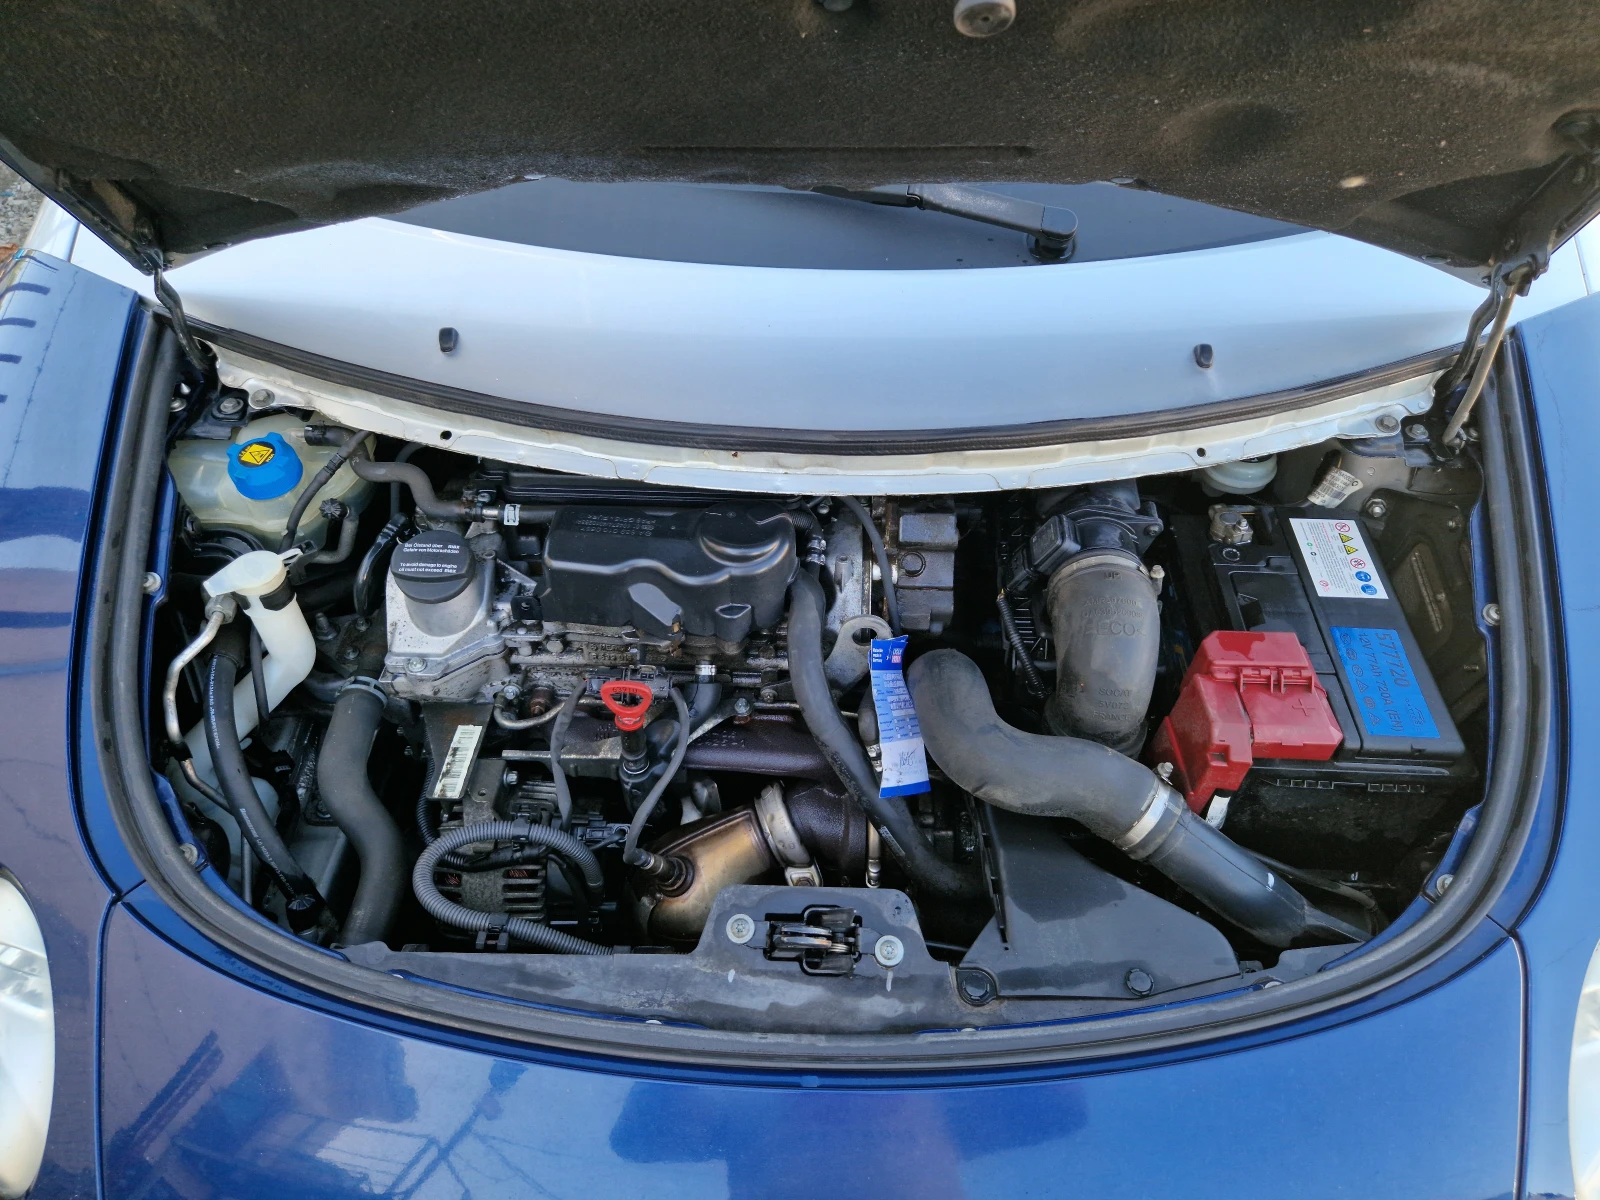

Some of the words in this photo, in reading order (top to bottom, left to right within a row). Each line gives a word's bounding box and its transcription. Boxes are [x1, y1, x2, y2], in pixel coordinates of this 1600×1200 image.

[1358, 633, 1372, 651] 12V
[1365, 652, 1382, 678] 77Ah
[1376, 680, 1394, 706] 720A
[1375, 633, 1410, 688] 577720
